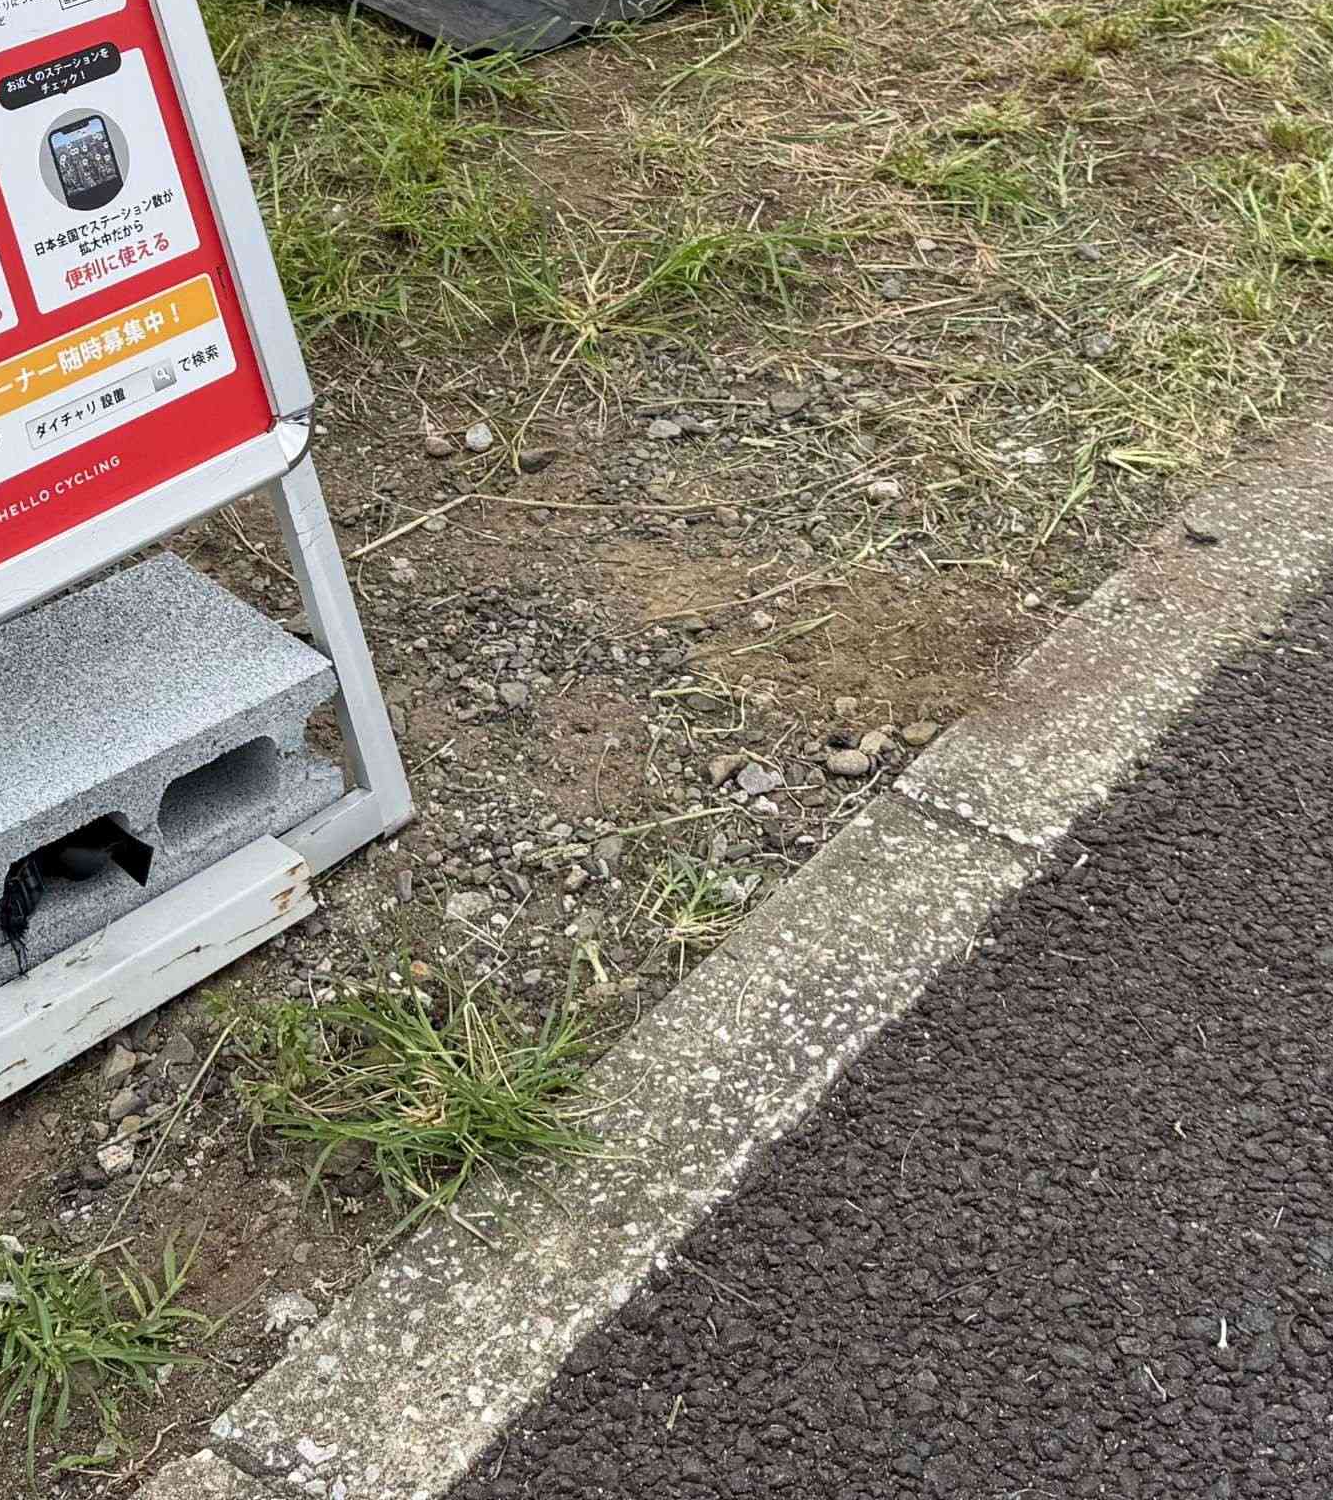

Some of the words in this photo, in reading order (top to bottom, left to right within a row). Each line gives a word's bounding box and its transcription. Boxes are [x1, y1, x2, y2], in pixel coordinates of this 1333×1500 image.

[5, 47, 110, 93] お近くのステーションを
[33, 188, 174, 257] 日本全国でステーション数が
[78, 219, 145, 257] 拡大中だから
[64, 231, 171, 291] 便利に使える
[178, 343, 221, 373] で検索
[35, 400, 97, 439] ダイチャリ
[100, 386, 127, 410] 設置
[54, 454, 123, 495] CYCLING
